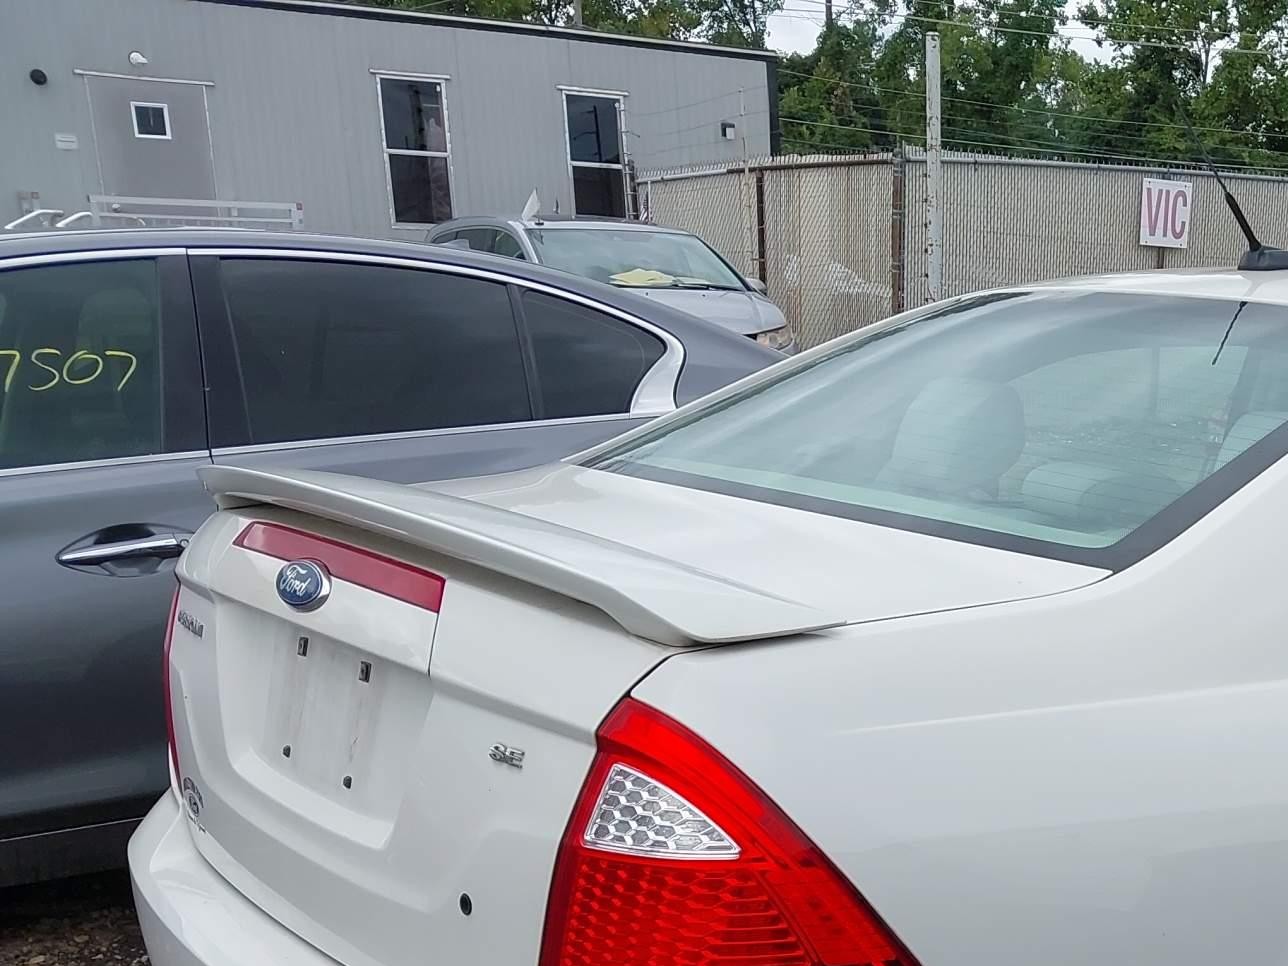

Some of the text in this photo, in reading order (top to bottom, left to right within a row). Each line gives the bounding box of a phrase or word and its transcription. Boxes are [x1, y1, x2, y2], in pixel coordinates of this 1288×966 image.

[1146, 187, 1188, 240] VIC
[0, 348, 137, 393] 7507
[280, 565, 312, 597] Ford
[488, 743, 526, 769] SE
